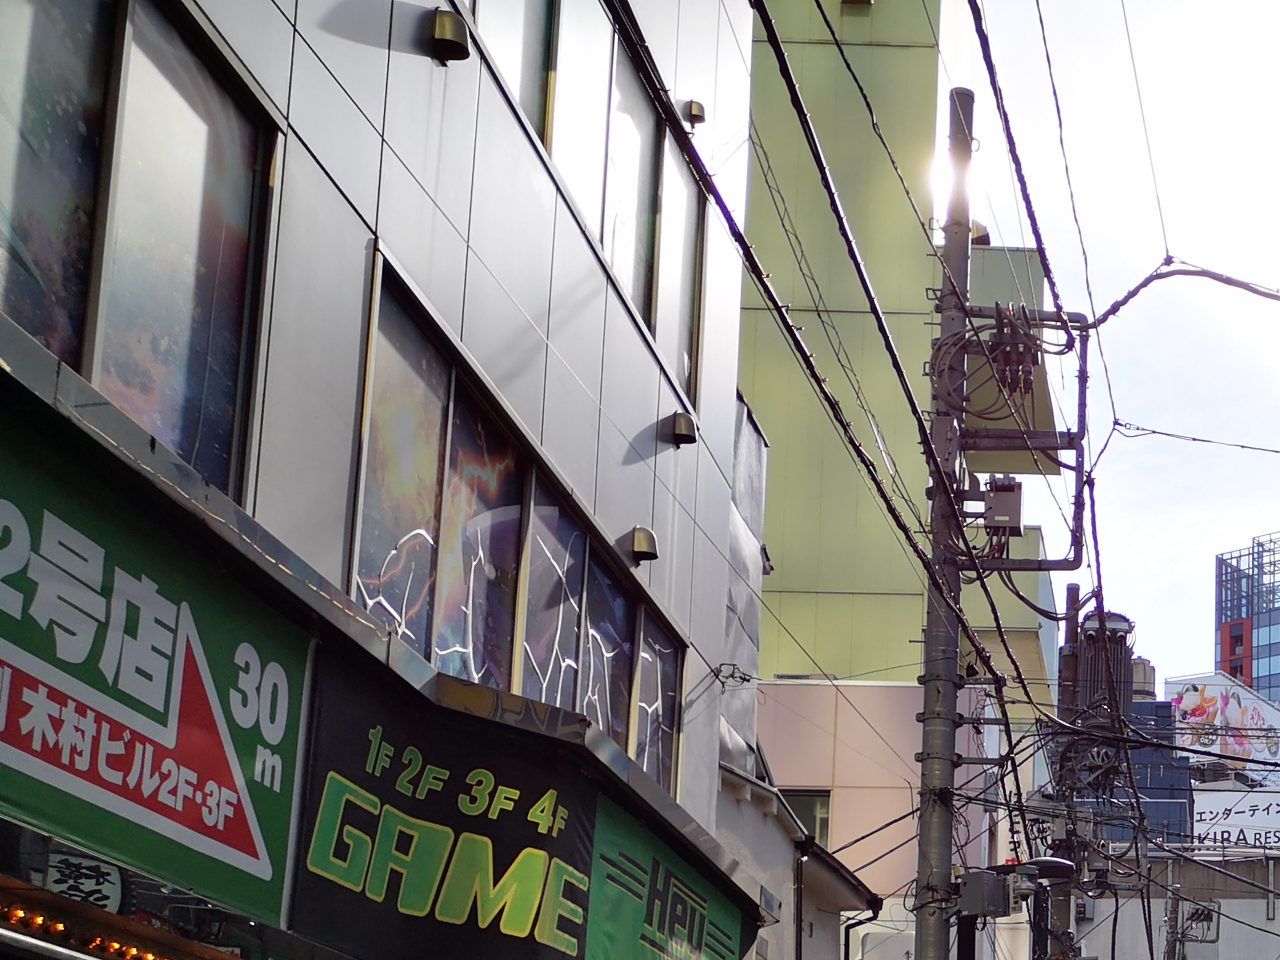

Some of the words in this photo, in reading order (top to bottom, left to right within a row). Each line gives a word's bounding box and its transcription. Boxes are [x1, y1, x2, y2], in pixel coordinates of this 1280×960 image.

[229, 642, 289, 745] 30
[254, 745, 282, 792] m
[365, 725, 394, 777] 1F
[395, 746, 450, 800] 2F
[457, 769, 520, 819] 3F
[527, 789, 569, 838] 4F
[306, 770, 590, 957] GAME
